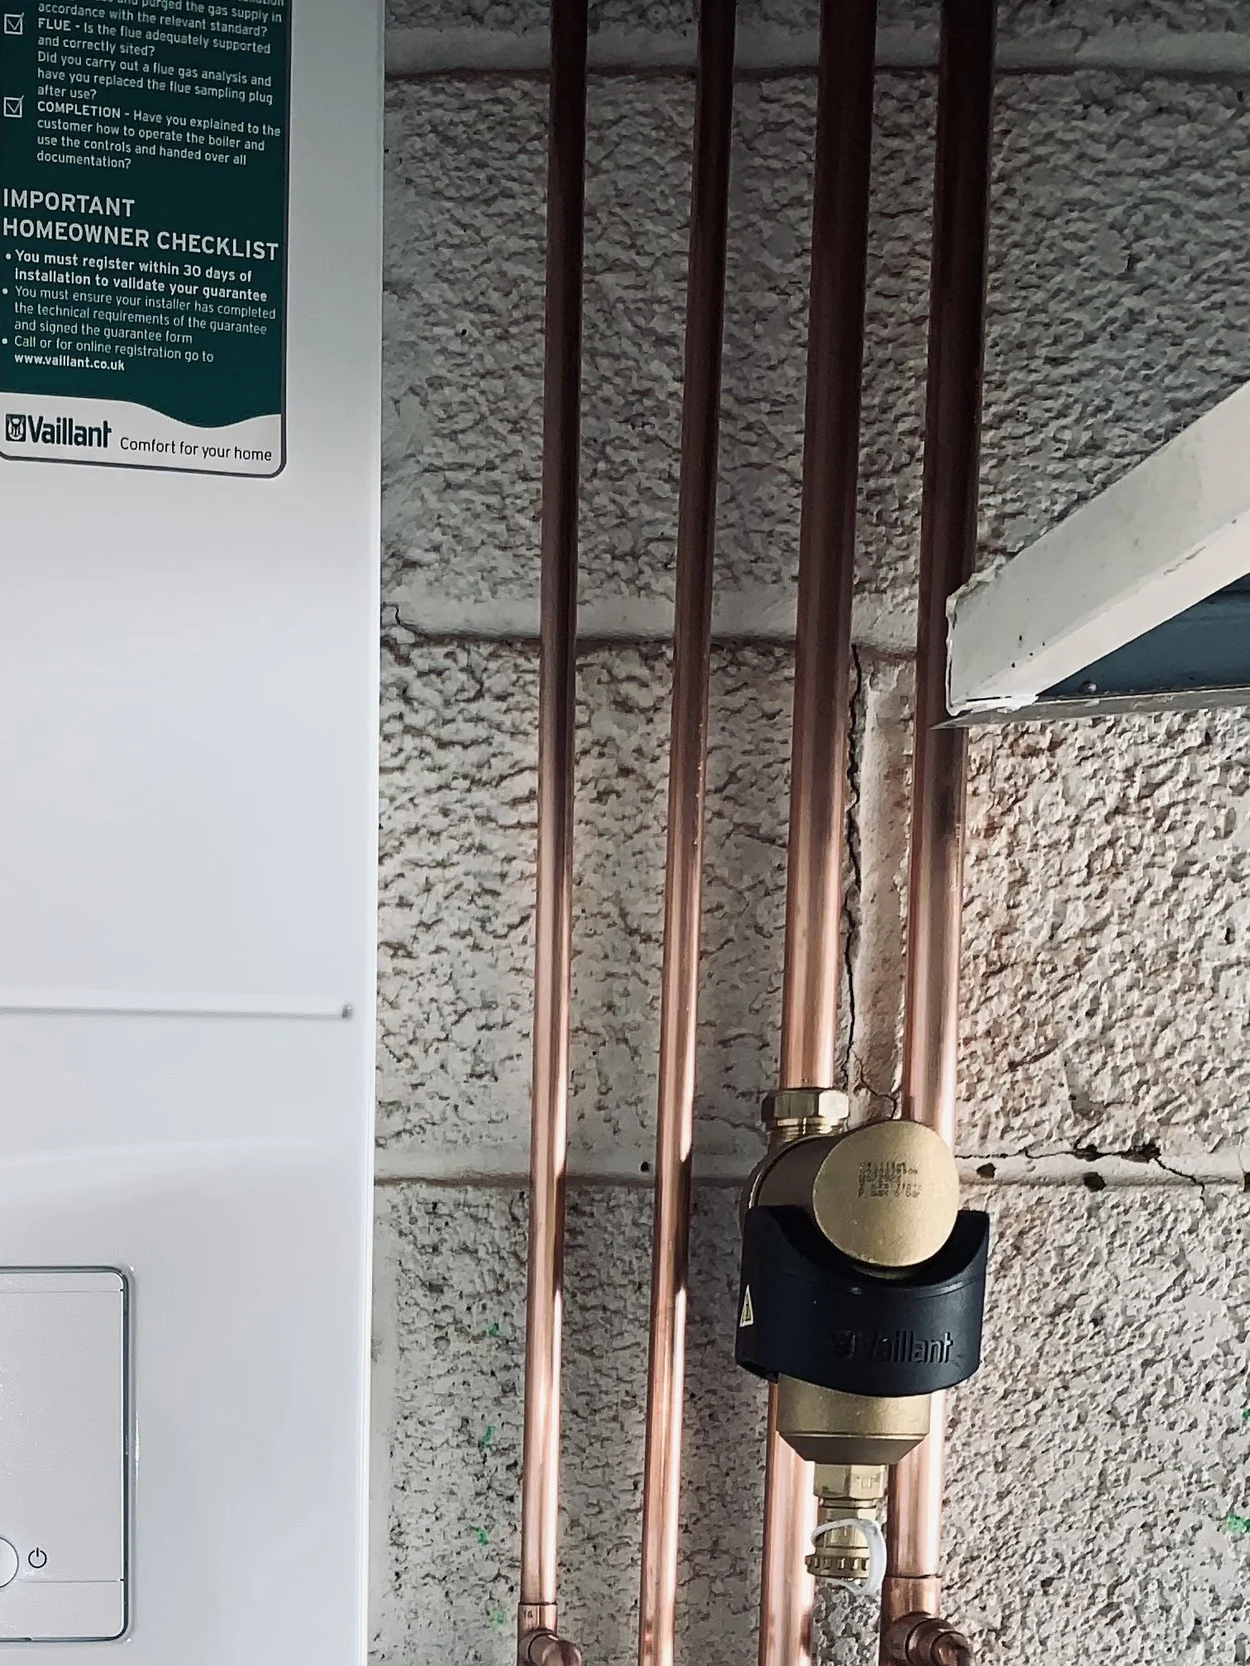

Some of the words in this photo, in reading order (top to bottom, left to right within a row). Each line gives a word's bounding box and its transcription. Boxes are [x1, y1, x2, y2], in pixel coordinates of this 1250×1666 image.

[38, 2, 105, 18] accordance
[108, 9, 133, 20] with
[137, 11, 156, 23] the
[159, 15, 205, 29] relevant
[210, 20, 267, 36] standard?
[141, 0, 182, 11] purged
[185, 2, 204, 12] the
[207, 5, 227, 16] gas
[231, 7, 268, 23] supply
[37, 36, 59, 46] and
[62, 38, 115, 54] correctly
[119, 43, 155, 56] sited?
[38, 17, 70, 31] FLUE
[97, 23, 116, 36] the
[120, 26, 141, 38] flue
[145, 30, 209, 48] adequately
[212, 38, 270, 54] supported
[60, 55, 81, 66] you
[85, 57, 116, 70] carry
[119, 60, 138, 71] out
[142, 63, 149, 72] a
[153, 62, 174, 75] flue
[178, 67, 198, 79] gas
[201, 70, 247, 84] analysis
[250, 75, 271, 86] and
[37, 67, 65, 80] have
[68, 72, 89, 83] you
[93, 74, 143, 88] replaced
[147, 78, 165, 90] the
[169, 80, 190, 93] flue
[194, 85, 245, 102] sampling
[248, 90, 272, 105] plug
[37, 84, 66, 96] after
[69, 88, 96, 99] use?
[37, 100, 120, 118] COMPLETION
[133, 110, 162, 123] Have
[165, 115, 186, 126] you
[189, 118, 243, 132] explained
[247, 122, 258, 134] to
[262, 124, 280, 136] the
[37, 118, 92, 132] customer
[96, 122, 119, 134] how
[123, 125, 135, 136] to
[138, 129, 182, 141] operate
[186, 131, 204, 144] the
[208, 134, 240, 147] boiler
[244, 139, 264, 151] and
[36, 150, 131, 169] documentation?
[37, 135, 57, 145] use
[61, 135, 80, 148] the
[83, 139, 131, 153] controls
[134, 144, 155, 155] and
[159, 145, 201, 159] handed
[204, 152, 229, 162] over
[233, 154, 246, 165] all
[3, 188, 134, 217] IMPORTANT
[3, 217, 149, 247] HOMEOWNER
[157, 231, 278, 260] CHECKLIST
[14, 248, 39, 262] You
[44, 253, 78, 266] must
[82, 256, 134, 270] register
[138, 260, 179, 275] within
[183, 264, 201, 277] 30
[205, 266, 235, 282] days
[239, 270, 251, 282] of
[15, 285, 36, 297] You
[40, 288, 68, 300] must
[72, 291, 111, 303] ensure
[115, 295, 141, 306] your
[145, 296, 190, 310] installer
[194, 300, 213, 313] has
[217, 305, 275, 319] completed
[95, 274, 108, 286] to
[113, 276, 164, 291] validate
[169, 283, 198, 295] your
[202, 286, 266, 302] guarantee
[14, 301, 33, 314] the
[37, 303, 89, 318] technical
[93, 309, 169, 325] requirements
[173, 315, 184, 326] of
[188, 316, 206, 328] the
[209, 320, 266, 335] guarantee
[14, 319, 35, 331] and
[39, 320, 77, 335] signed
[81, 323, 100, 335] the
[103, 327, 161, 341] guarantee
[165, 330, 192, 343] form
[14, 334, 35, 347] Call
[39, 339, 52, 348] or
[56, 337, 72, 350] for
[76, 339, 111, 353] online
[114, 343, 181, 359] registration
[184, 351, 198, 362] go
[202, 350, 213, 362] to
[14, 354, 124, 370] www.vaillant.co.uk
[27, 415, 111, 448] Vaillant
[120, 436, 175, 454] Comfort
[179, 440, 198, 455] for
[201, 446, 230, 459] your
[234, 445, 271, 461] home
